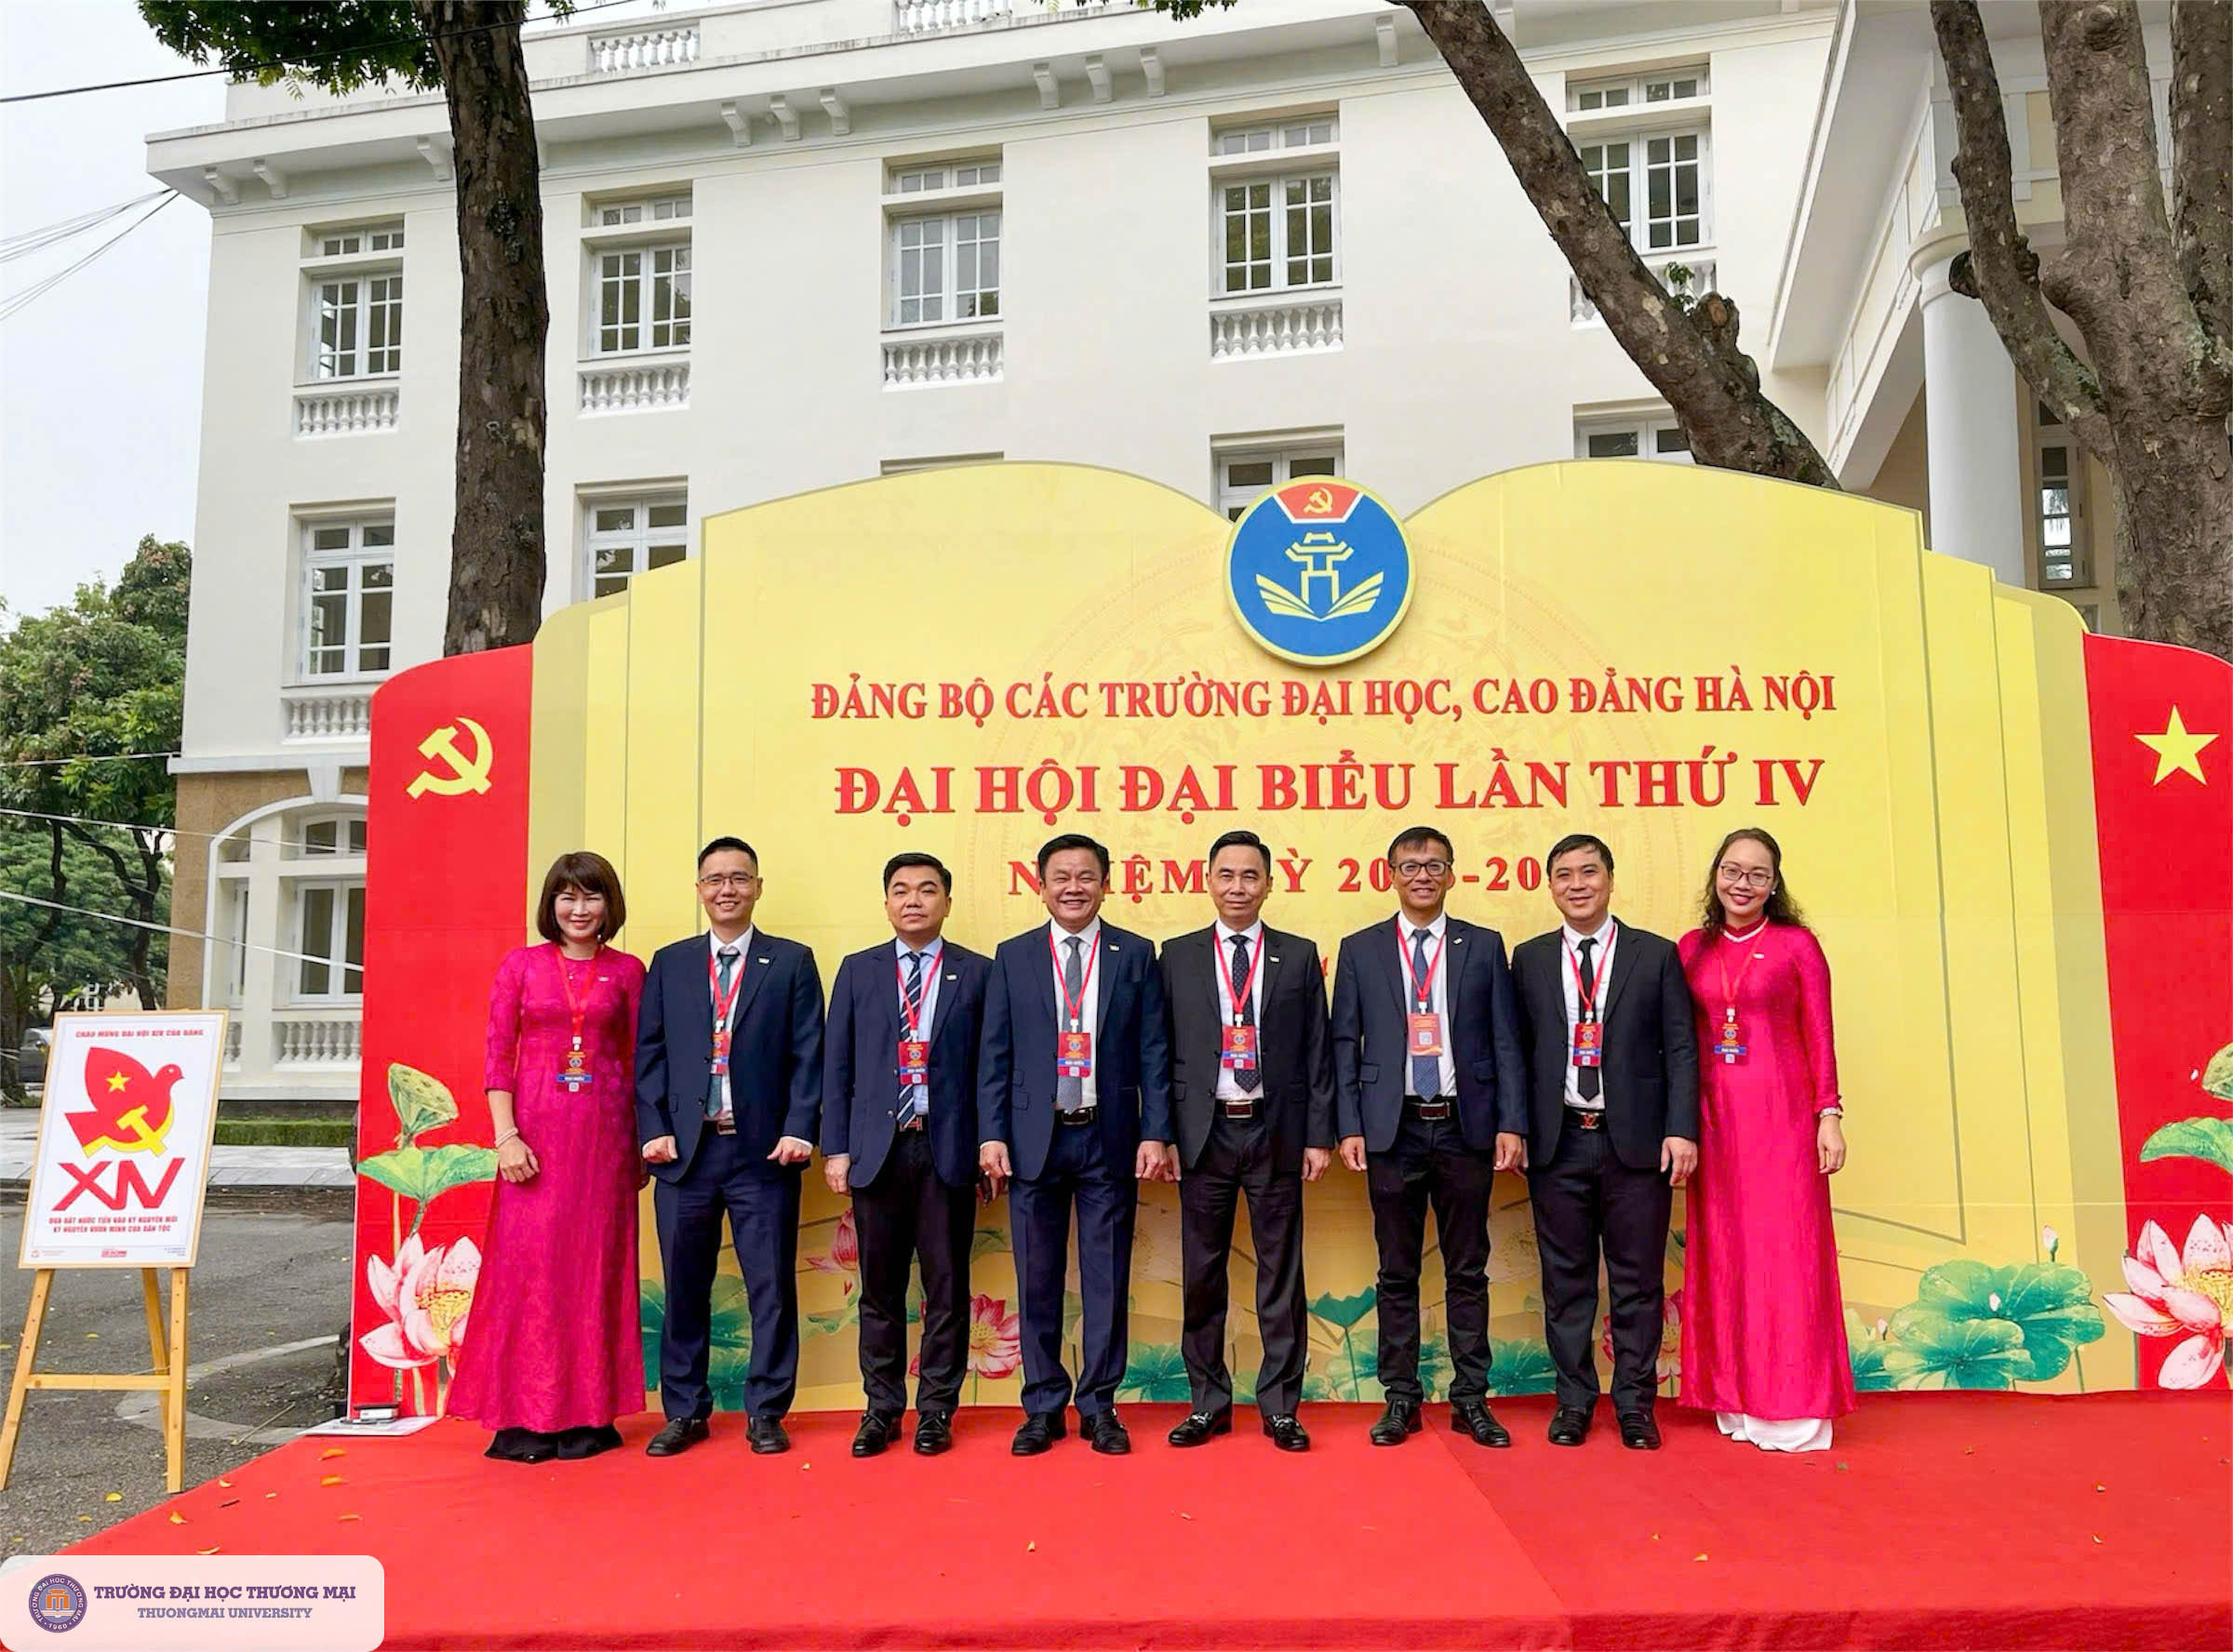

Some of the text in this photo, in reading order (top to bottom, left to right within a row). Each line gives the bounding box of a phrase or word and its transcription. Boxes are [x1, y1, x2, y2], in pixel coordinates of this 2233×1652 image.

[812, 664, 1837, 727] ĐẢNG BỘ CÁC TRƯỜNG ĐẠI HỌC, CAO ĐẲNG HÀ NỘI
[835, 744, 1825, 827] ĐẠI HỘI ĐẠI BIỂU LẦN THỨ IV
[1008, 853, 1208, 904] NỆM
